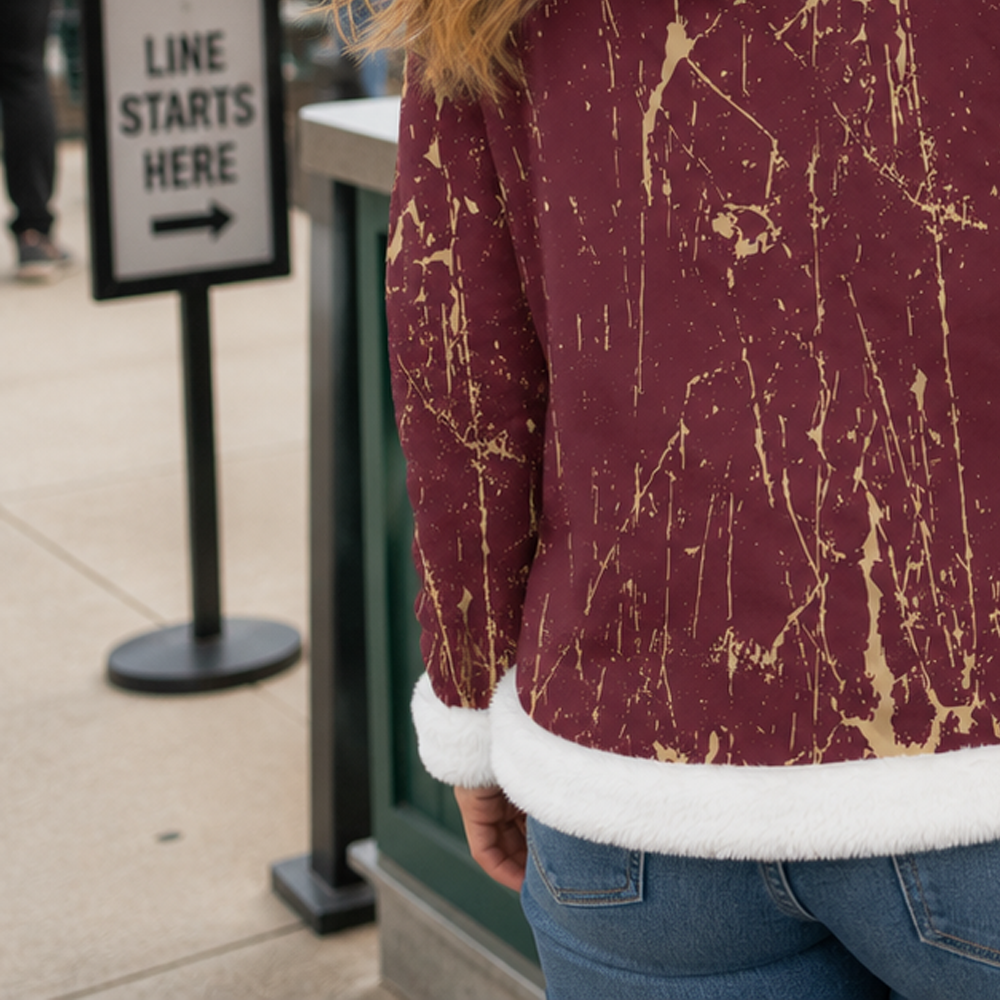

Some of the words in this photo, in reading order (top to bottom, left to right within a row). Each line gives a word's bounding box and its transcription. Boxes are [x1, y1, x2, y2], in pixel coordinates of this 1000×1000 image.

[144, 30, 226, 78] LINE
[119, 82, 257, 138] STARTS
[142, 141, 238, 192] HERE
